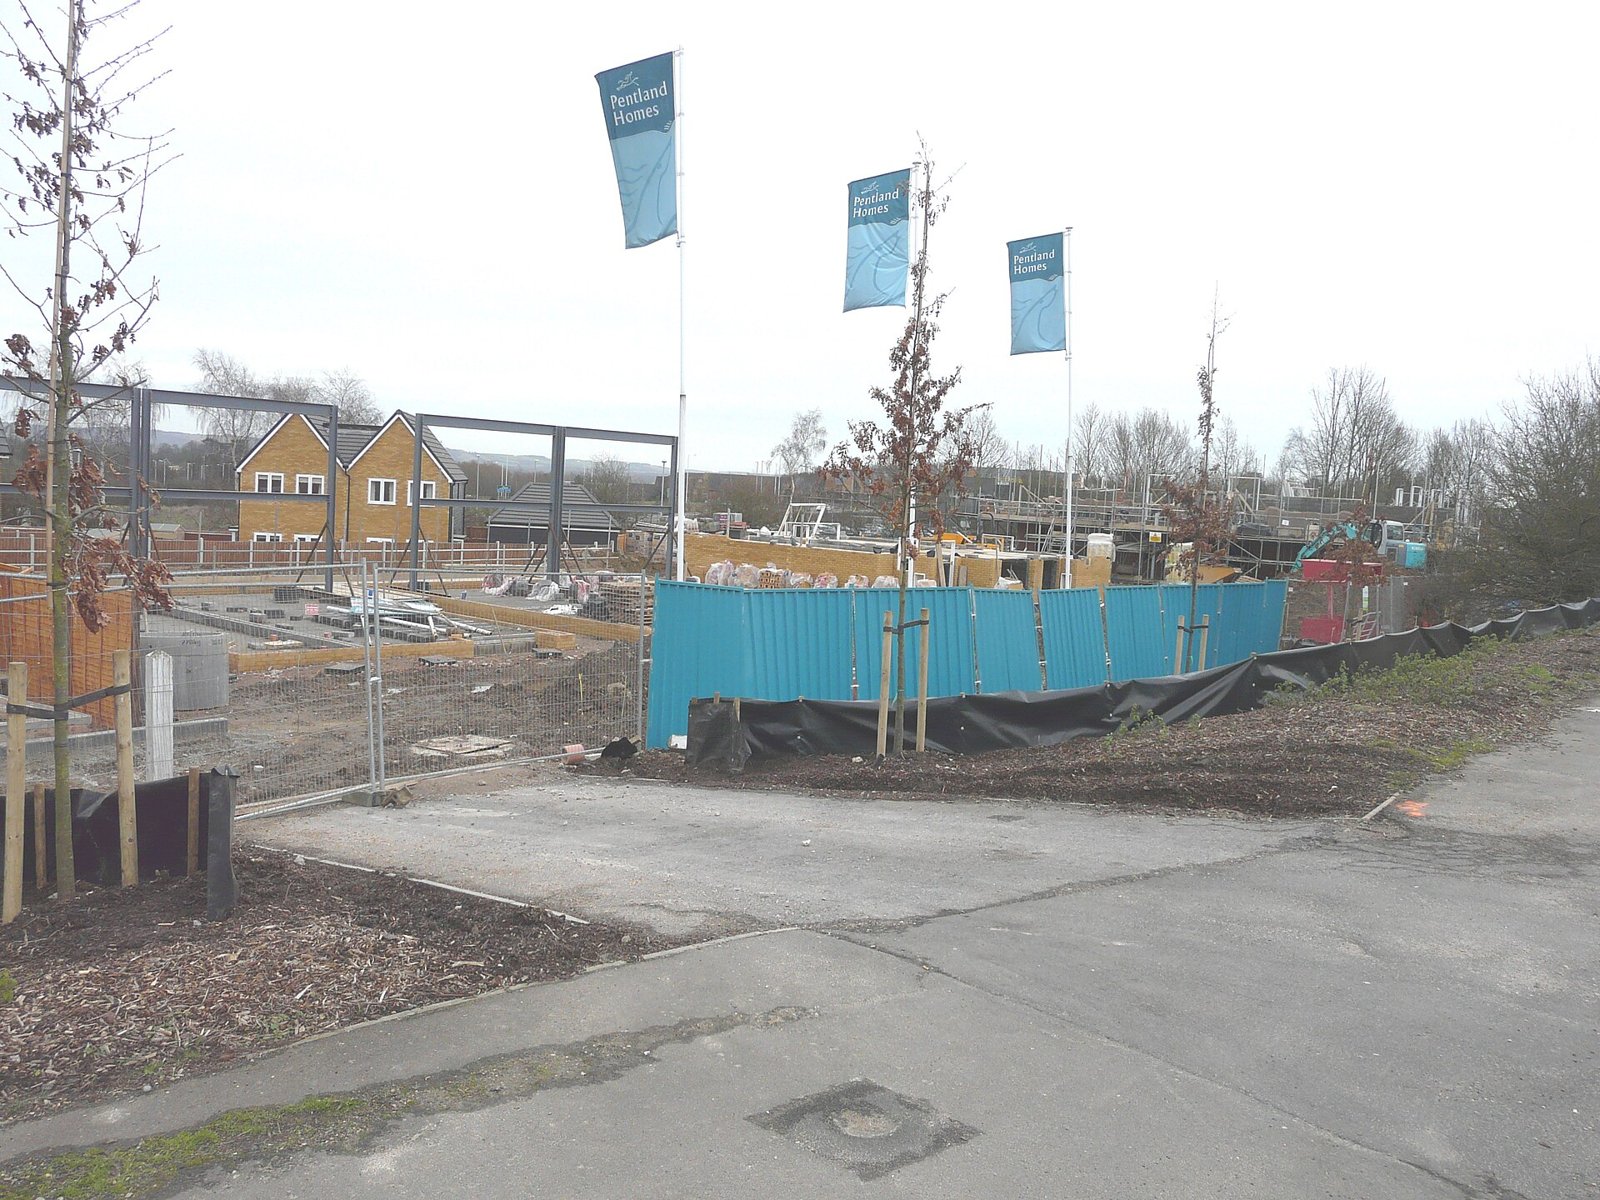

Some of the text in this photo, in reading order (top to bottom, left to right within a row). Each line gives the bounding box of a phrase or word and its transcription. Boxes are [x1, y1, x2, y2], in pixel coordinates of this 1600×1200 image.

[610, 81, 668, 110] Pentland
[613, 105, 659, 126] Homes
[854, 188, 899, 206] Pentland
[853, 204, 889, 218] Homes
[1014, 249, 1055, 264] Pentland
[1014, 263, 1047, 274] Homes
